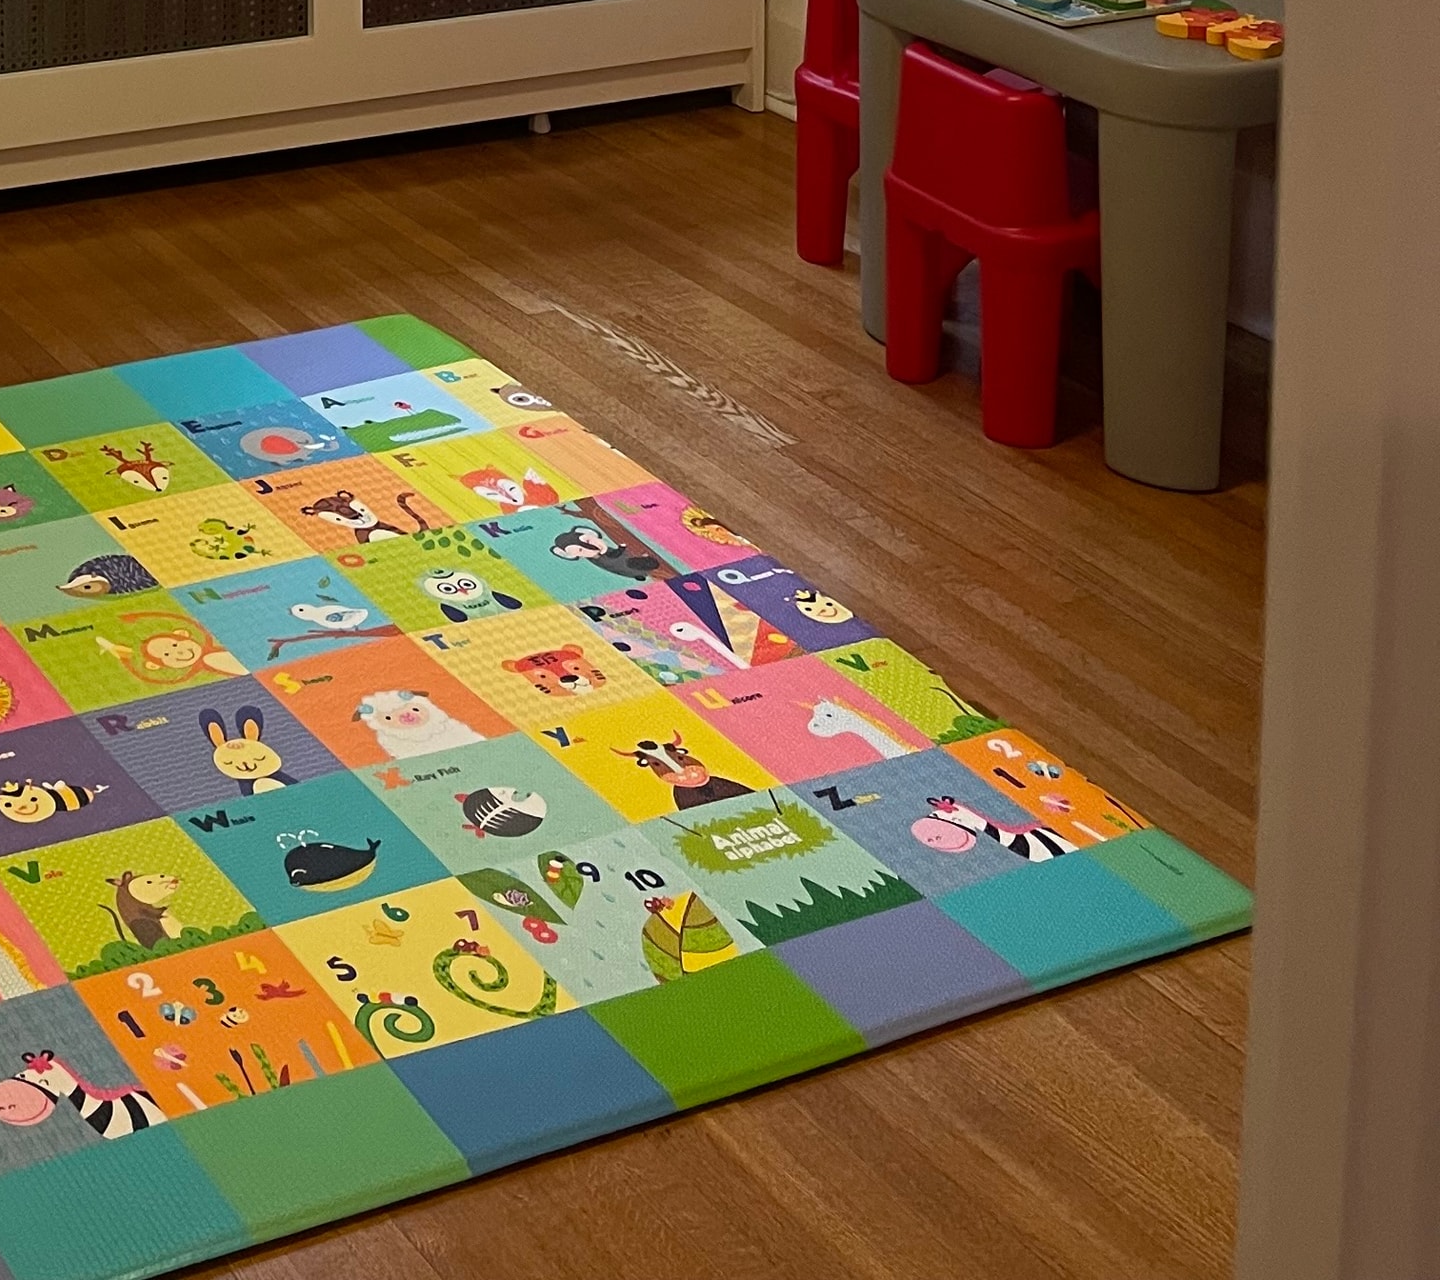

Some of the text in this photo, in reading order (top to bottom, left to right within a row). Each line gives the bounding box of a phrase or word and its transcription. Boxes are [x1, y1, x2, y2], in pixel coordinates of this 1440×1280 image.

[987, 739, 1022, 758] 2
[437, 765, 460, 777] Fish
[188, 810, 255, 832] Whale
[711, 816, 789, 850] Animal
[723, 831, 802, 860] alphabet
[575, 862, 600, 882] 9
[624, 869, 665, 890] 10
[381, 902, 409, 922] 6
[454, 909, 479, 931] 7
[522, 916, 558, 943] 8
[234, 951, 266, 974] 4
[325, 956, 357, 982] 5
[126, 972, 162, 998] 2
[192, 978, 224, 1005] 3
[117, 1009, 145, 1038] 1
